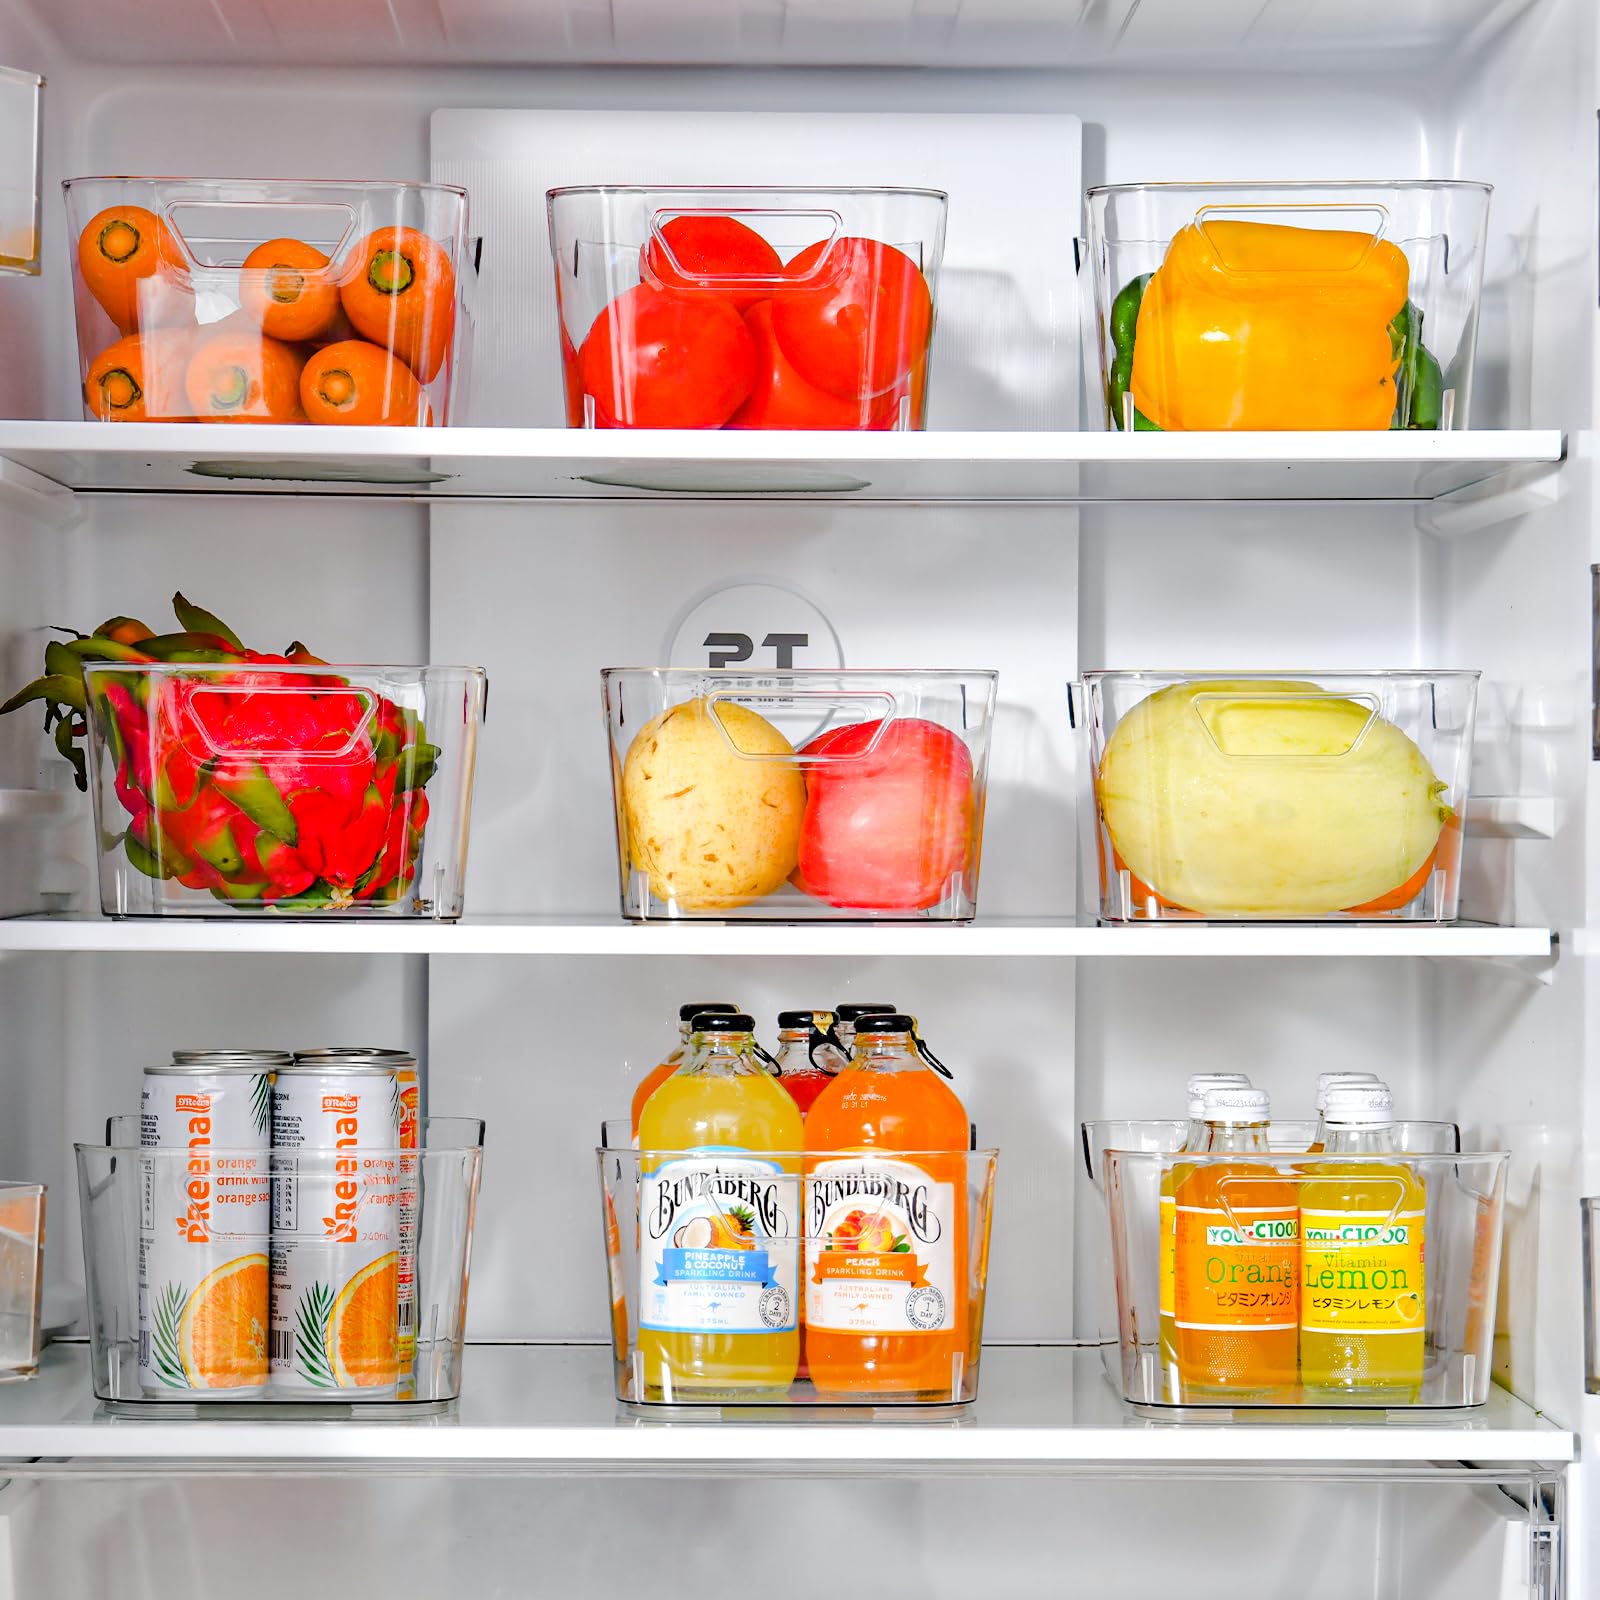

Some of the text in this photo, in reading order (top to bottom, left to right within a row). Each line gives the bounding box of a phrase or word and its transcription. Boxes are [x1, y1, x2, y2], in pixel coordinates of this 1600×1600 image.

[217, 1159, 257, 1171] orange
[217, 1193, 257, 1206] orange
[367, 1195, 394, 1207] range
[685, 1251, 745, 1263] PINEAPPLE
[845, 1258, 881, 1267] PEACH
[1323, 1254, 1388, 1269] Vitamin
[694, 1261, 745, 1271] COCONUT
[826, 1267, 905, 1277] SPARKLING DRINK
[675, 1269, 757, 1279] SPARKLING DRINK
[1206, 1257, 1301, 1289] Orang
[1305, 1263, 1409, 1290] Lemon
[1216, 1291, 1292, 1307] ビタミンオレンジ
[1312, 1297, 1395, 1309] ビタミンレモン
